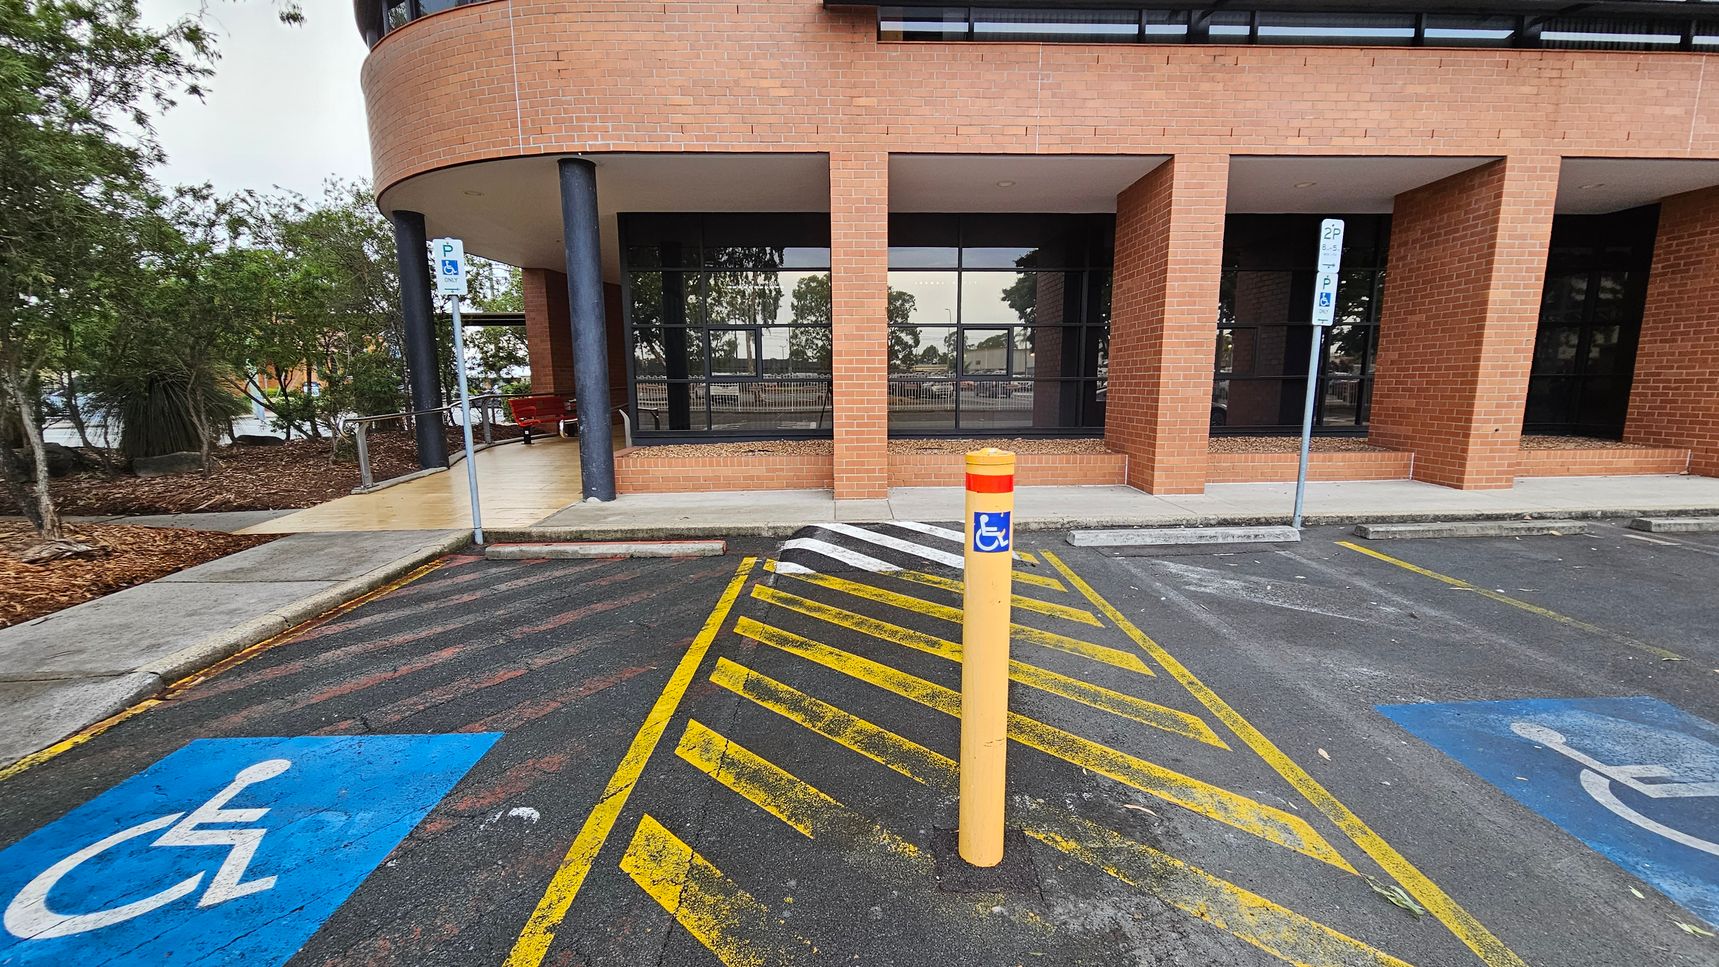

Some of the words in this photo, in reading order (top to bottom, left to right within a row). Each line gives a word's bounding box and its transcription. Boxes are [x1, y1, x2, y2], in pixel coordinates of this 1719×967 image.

[1323, 227, 1341, 240] 2P
[442, 244, 454, 258] P
[1322, 277, 1332, 290] P
